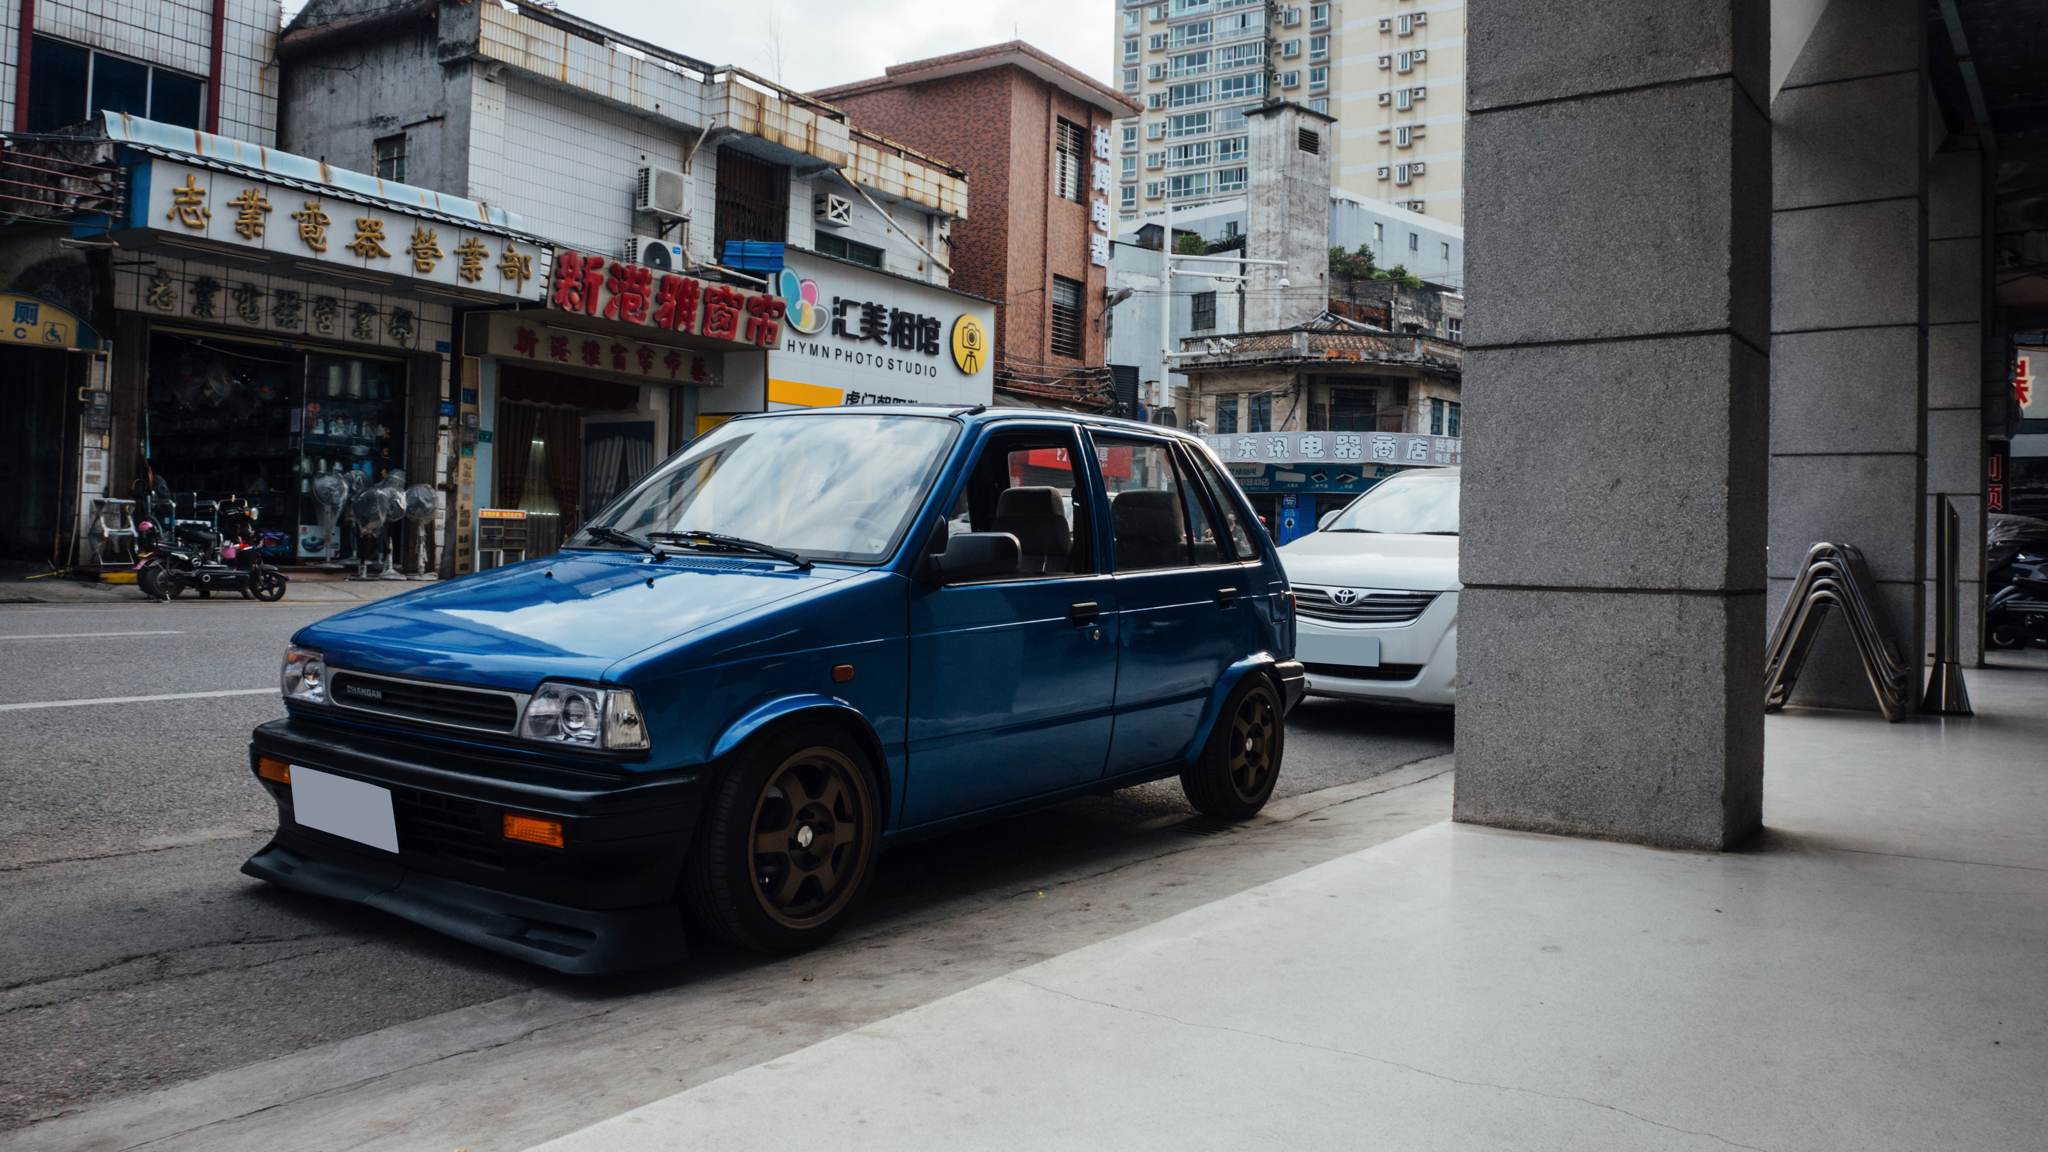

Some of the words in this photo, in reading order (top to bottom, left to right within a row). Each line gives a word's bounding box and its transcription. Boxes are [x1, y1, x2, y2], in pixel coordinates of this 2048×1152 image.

[167, 173, 532, 293] 志業電器營業部
[553, 250, 786, 346] 新港雅窗帘
[832, 296, 941, 356] 汇美相馆
[787, 339, 830, 358] HYMN
[835, 348, 884, 368] PHOTO
[887, 358, 937, 377] STUDIO
[1236, 434, 1429, 461] 东讯电器商店
[346, 685, 382, 699] CHANGAN
